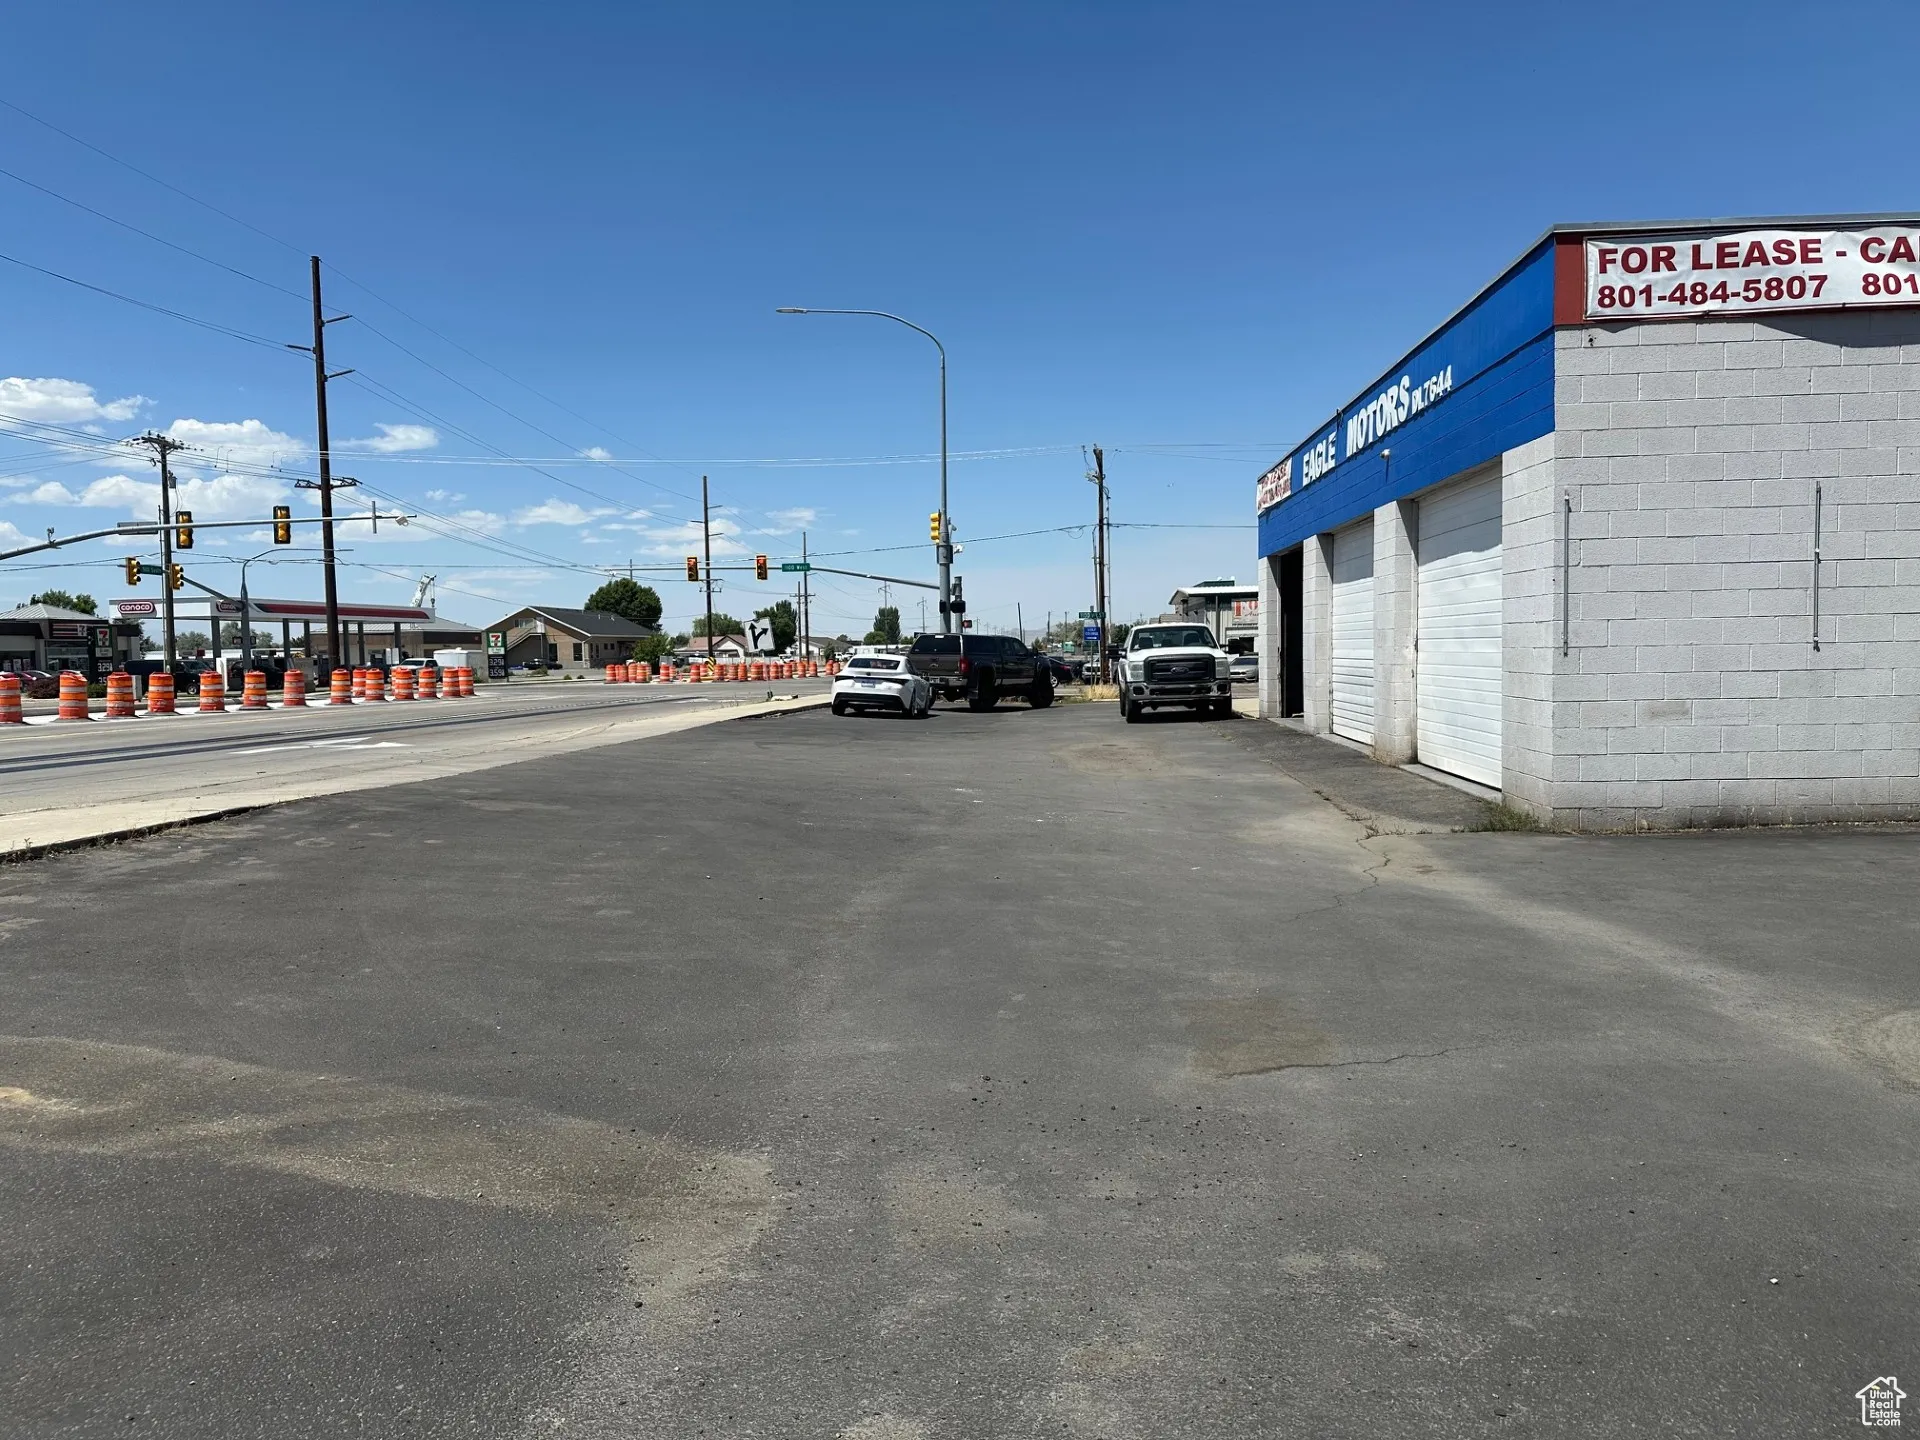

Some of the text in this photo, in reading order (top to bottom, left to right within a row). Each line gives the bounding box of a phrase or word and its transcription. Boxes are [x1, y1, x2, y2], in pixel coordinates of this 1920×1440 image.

[1598, 246, 1677, 274] FOR
[1691, 238, 1824, 271] LEASE
[1859, 236, 1920, 263] CA
[1597, 274, 1828, 309] 801-484-5807
[1861, 272, 1920, 296] 801
[1302, 431, 1337, 487] EAGLE
[1346, 375, 1411, 459] MOTORS
